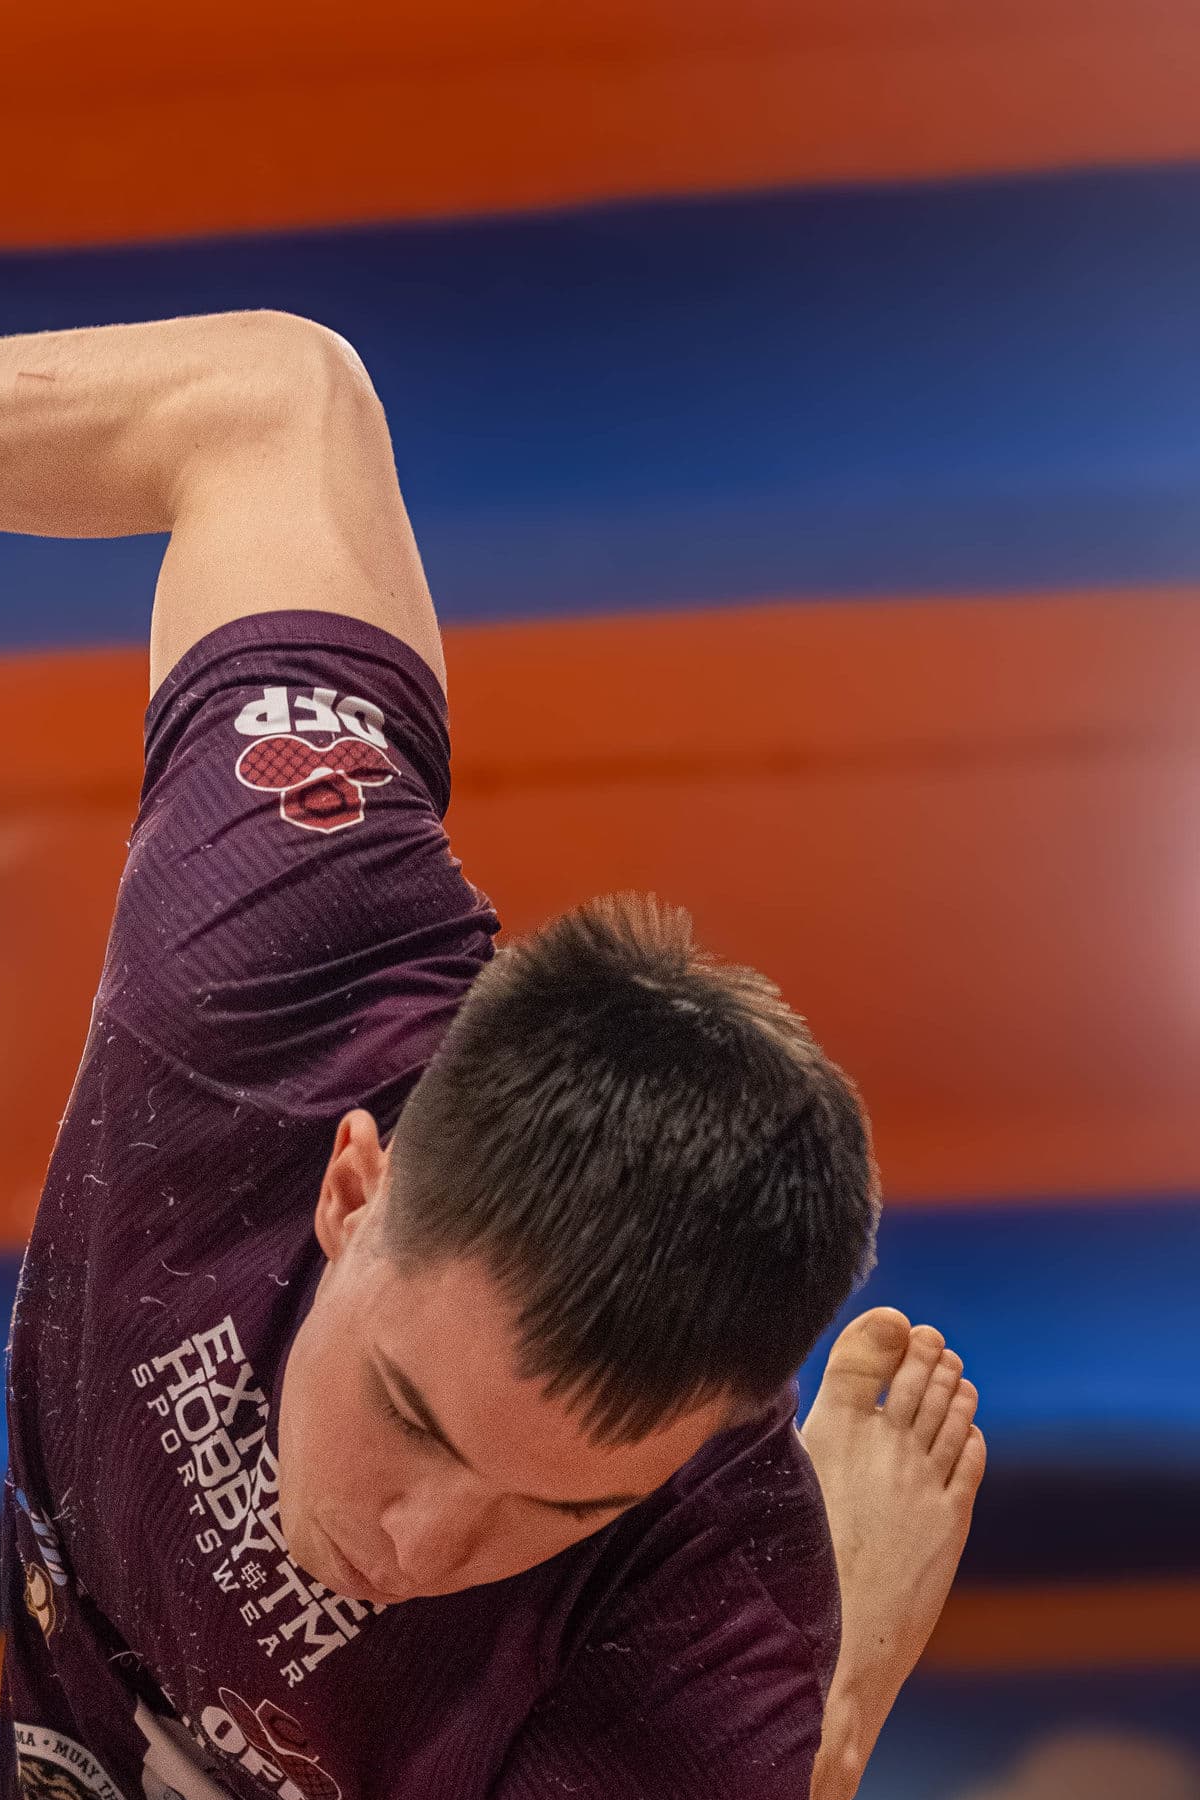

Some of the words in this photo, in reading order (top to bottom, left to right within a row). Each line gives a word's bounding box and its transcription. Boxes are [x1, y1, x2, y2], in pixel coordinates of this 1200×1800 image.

[131, 1362, 305, 1688] SPORTSWEAR
[151, 1338, 278, 1561] HOBBY
[192, 1314, 388, 1641] EXTRE
[16, 1730, 36, 1747] MA
[52, 1739, 100, 1779] MUAY
